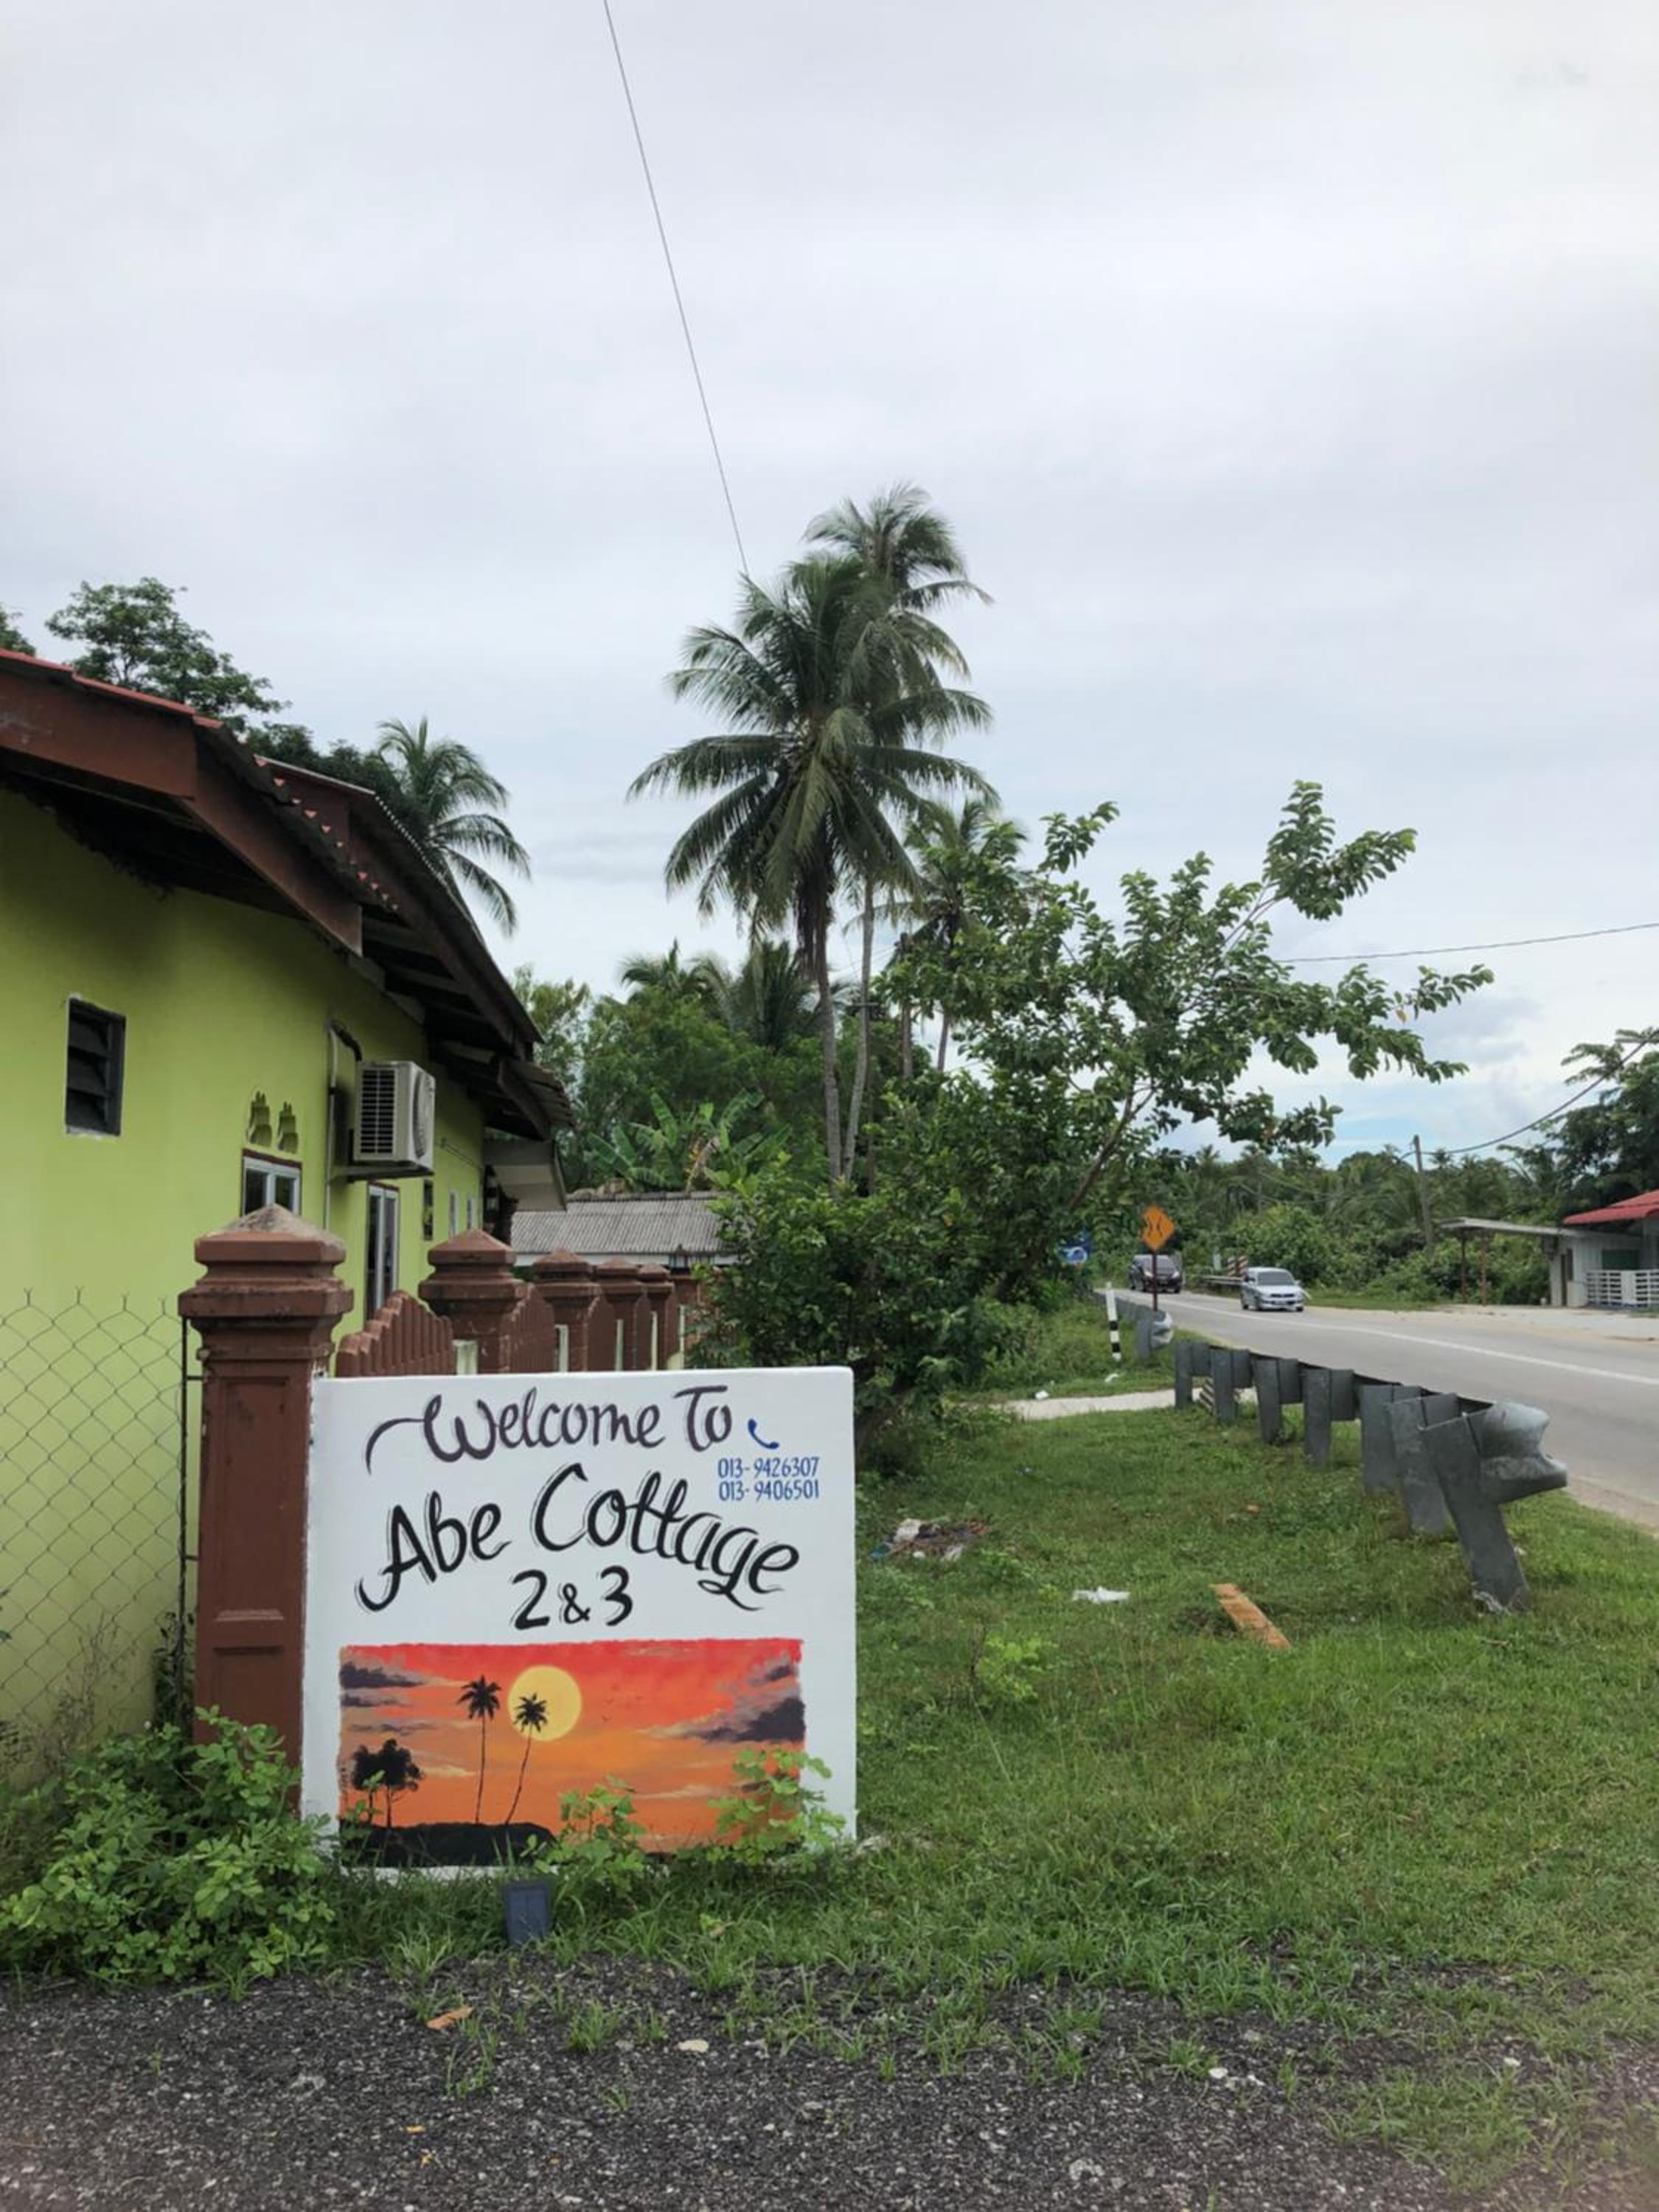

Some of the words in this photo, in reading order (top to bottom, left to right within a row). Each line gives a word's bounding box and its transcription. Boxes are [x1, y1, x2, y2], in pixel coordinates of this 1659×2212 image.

[364, 1386, 666, 1475] Welcome
[672, 1385, 733, 1452] To
[355, 1490, 512, 1612] Abe
[529, 1463, 800, 1611] Cottage
